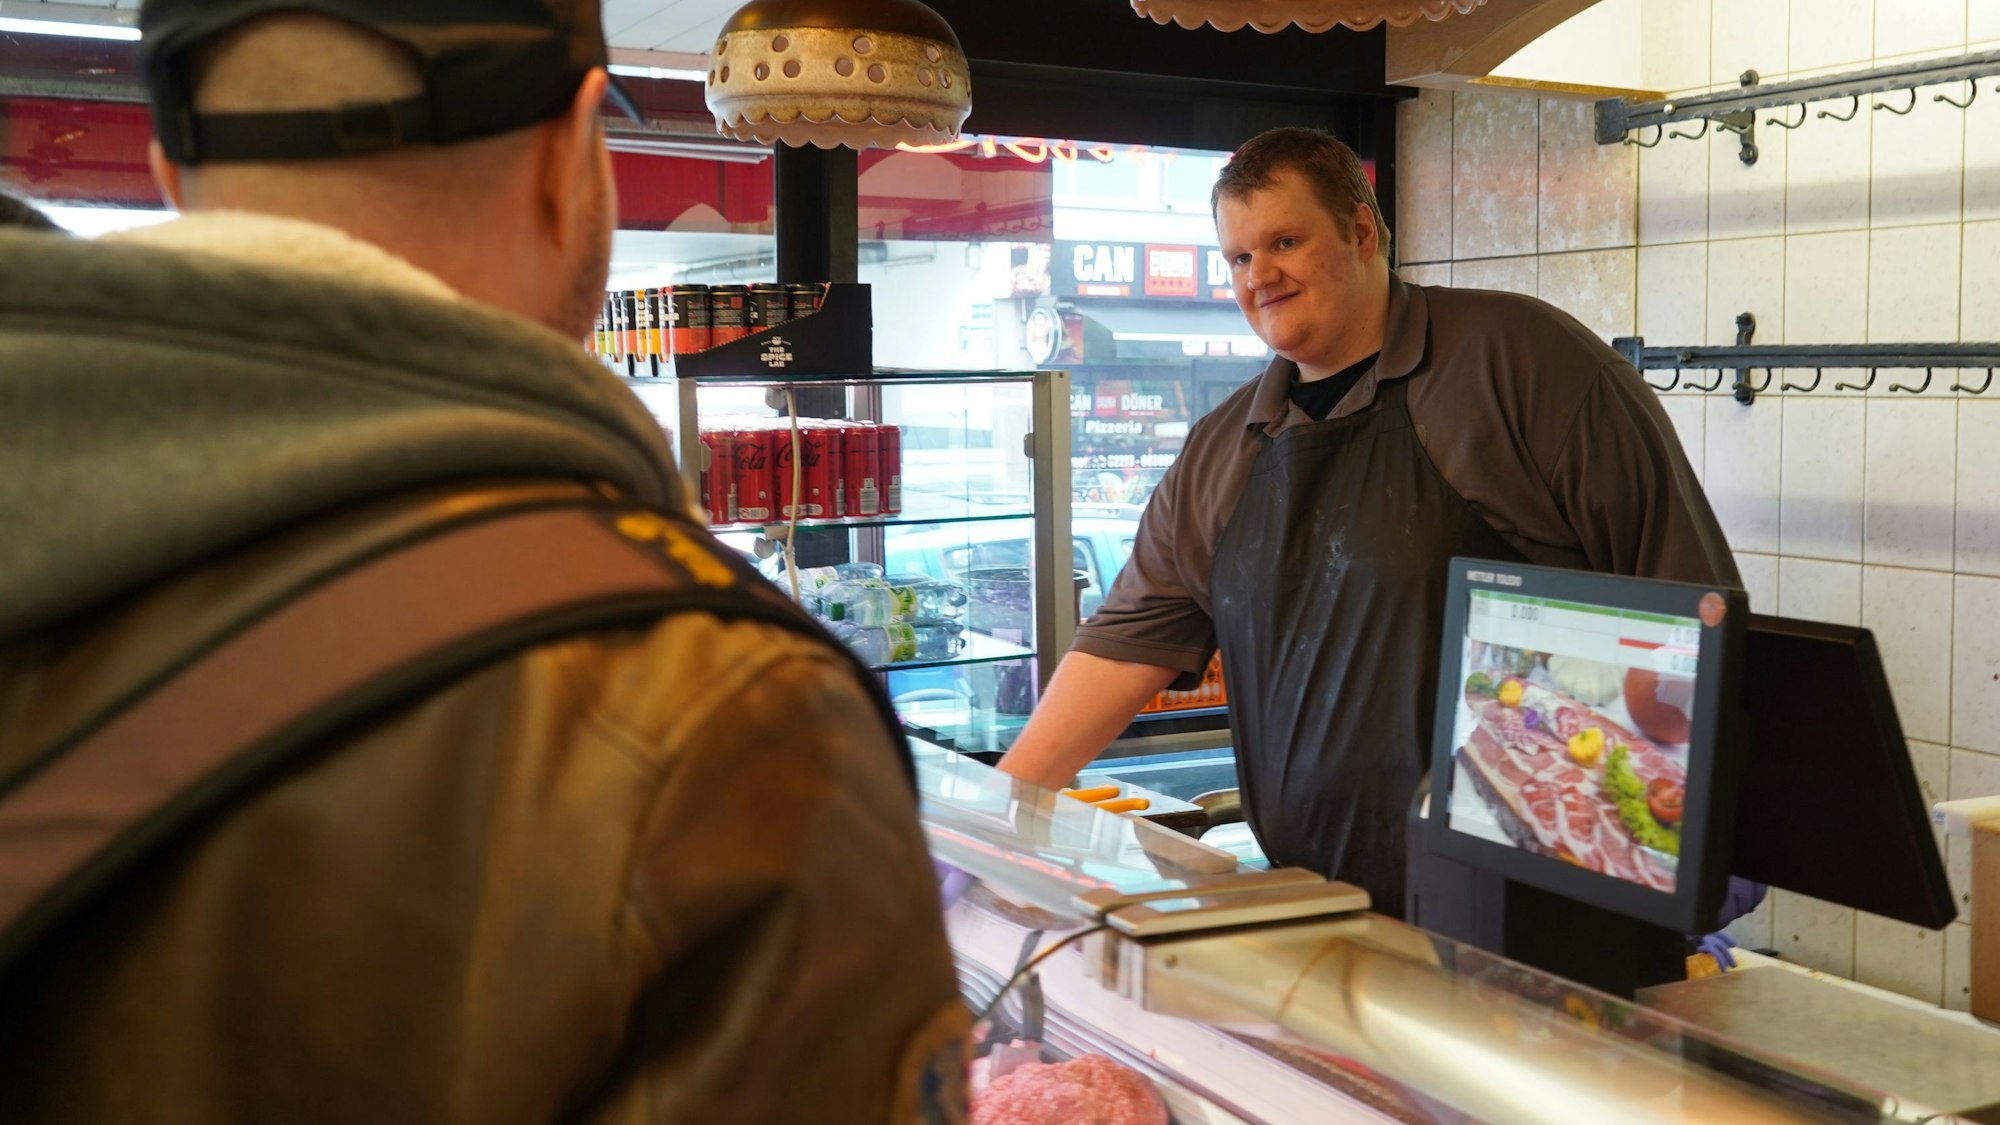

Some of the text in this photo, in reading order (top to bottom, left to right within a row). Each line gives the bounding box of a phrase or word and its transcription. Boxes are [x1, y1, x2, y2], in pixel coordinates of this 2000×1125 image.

[1073, 244, 1134, 283] CAN
[760, 353, 793, 361] SPICE
[1070, 394, 1092, 411] CAN
[1121, 392, 1163, 411] DÖNER
[1086, 419, 1142, 434] Pizzeria
